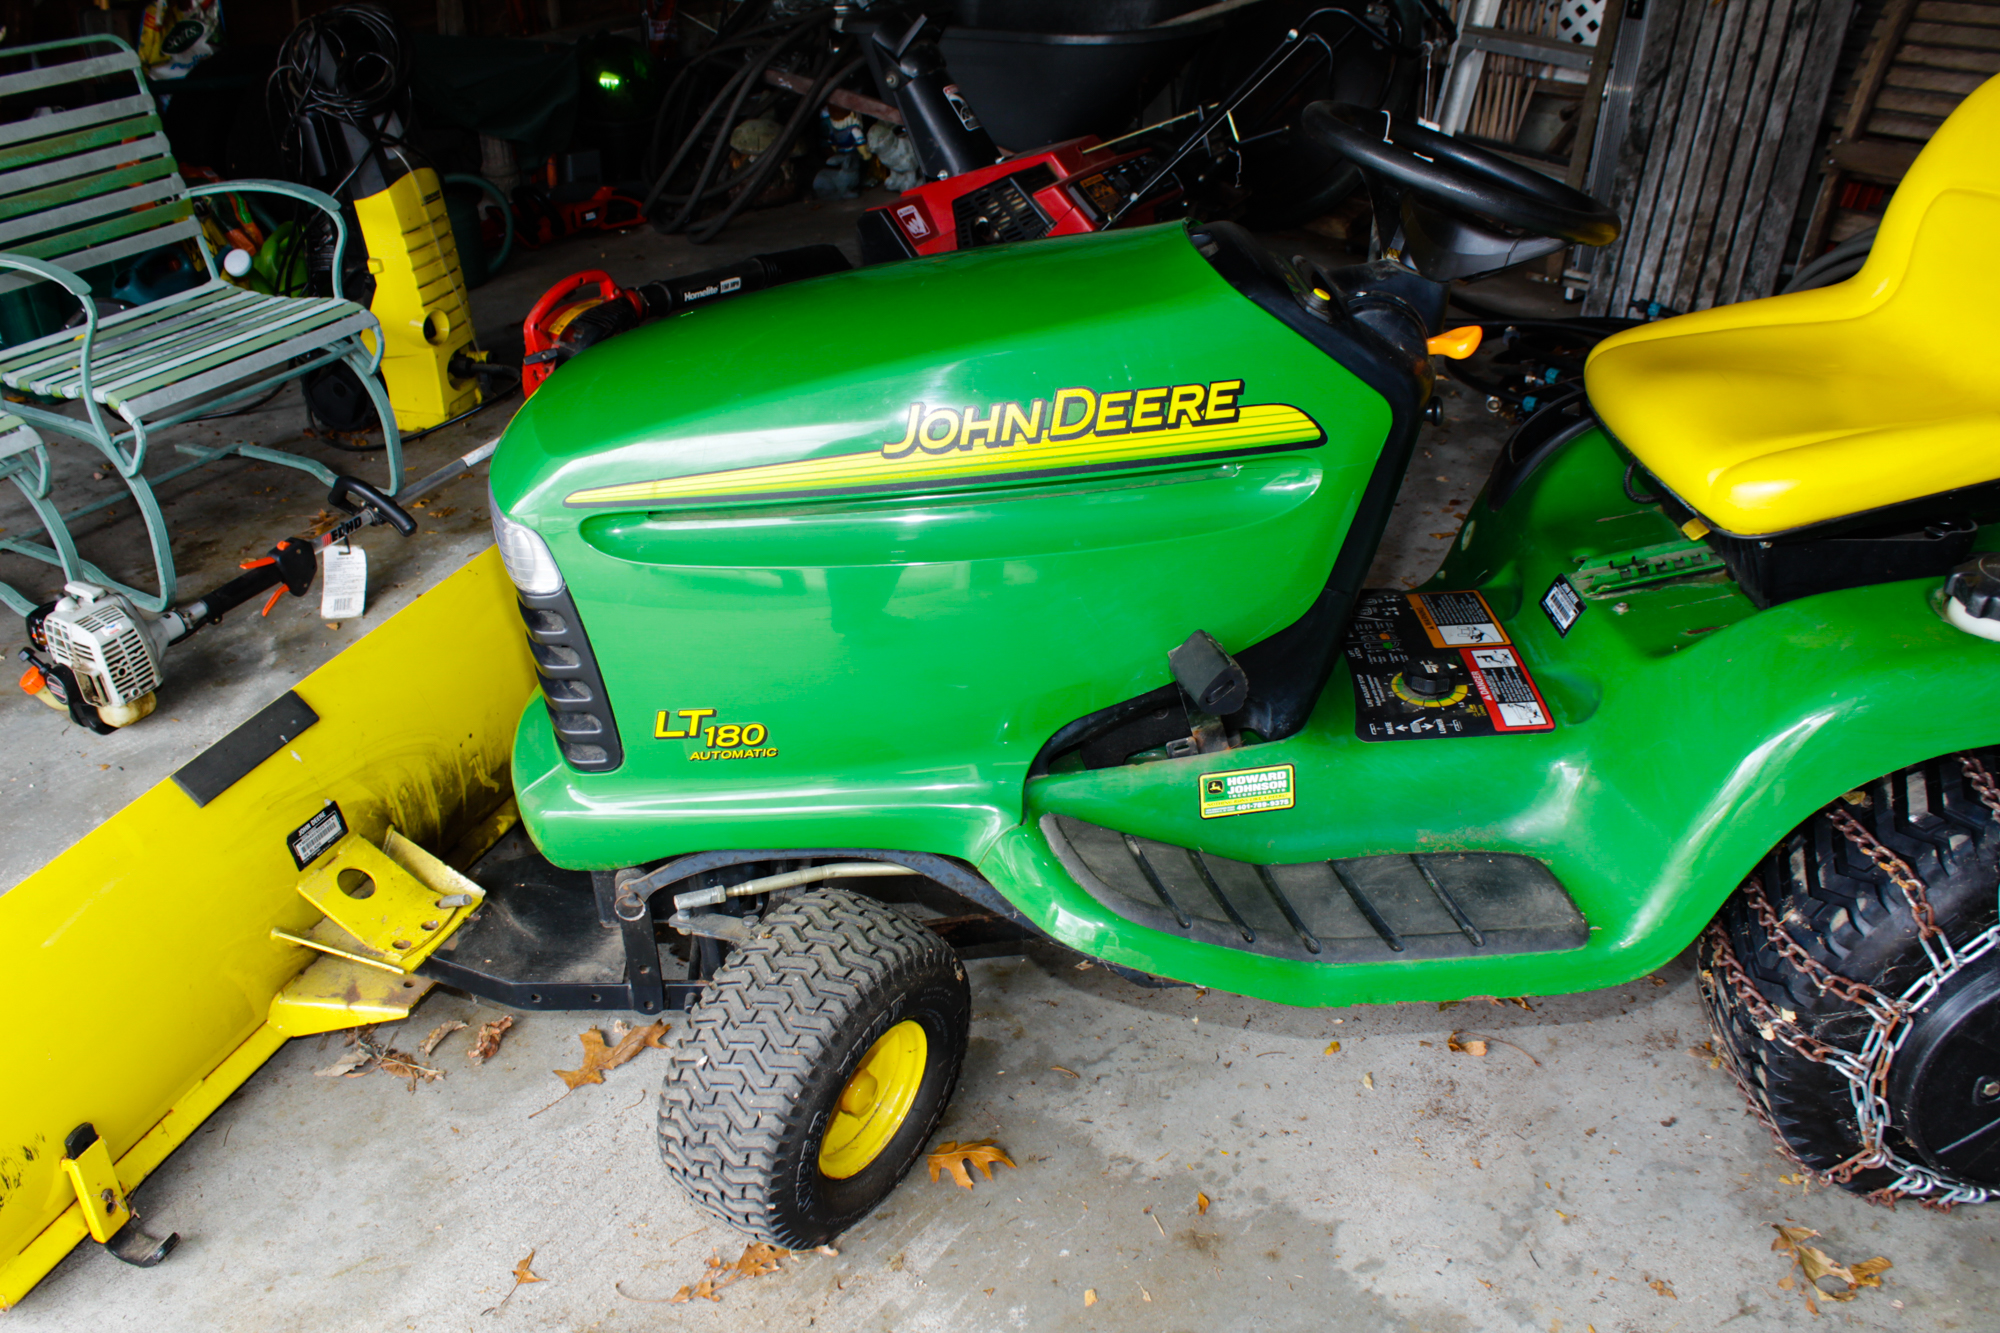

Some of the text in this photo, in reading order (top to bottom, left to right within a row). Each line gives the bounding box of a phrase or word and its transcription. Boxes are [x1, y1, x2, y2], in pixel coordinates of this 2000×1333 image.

[684, 286, 719, 302] Homelite
[881, 379, 1246, 460] JOHN DEERE
[331, 516, 362, 542] ECHO
[1470, 670, 1491, 695] DANGER
[654, 708, 768, 749] LT 180
[689, 747, 779, 761] AUTOMATIC
[1226, 771, 1287, 787] HOWARD
[1226, 780, 1287, 795] JOHNSON
[1228, 788, 1287, 799] INCORPORATED
[1236, 798, 1289, 811] 401-789-9375
[298, 822, 312, 837] JOHN
[310, 810, 327, 826] DEERE
